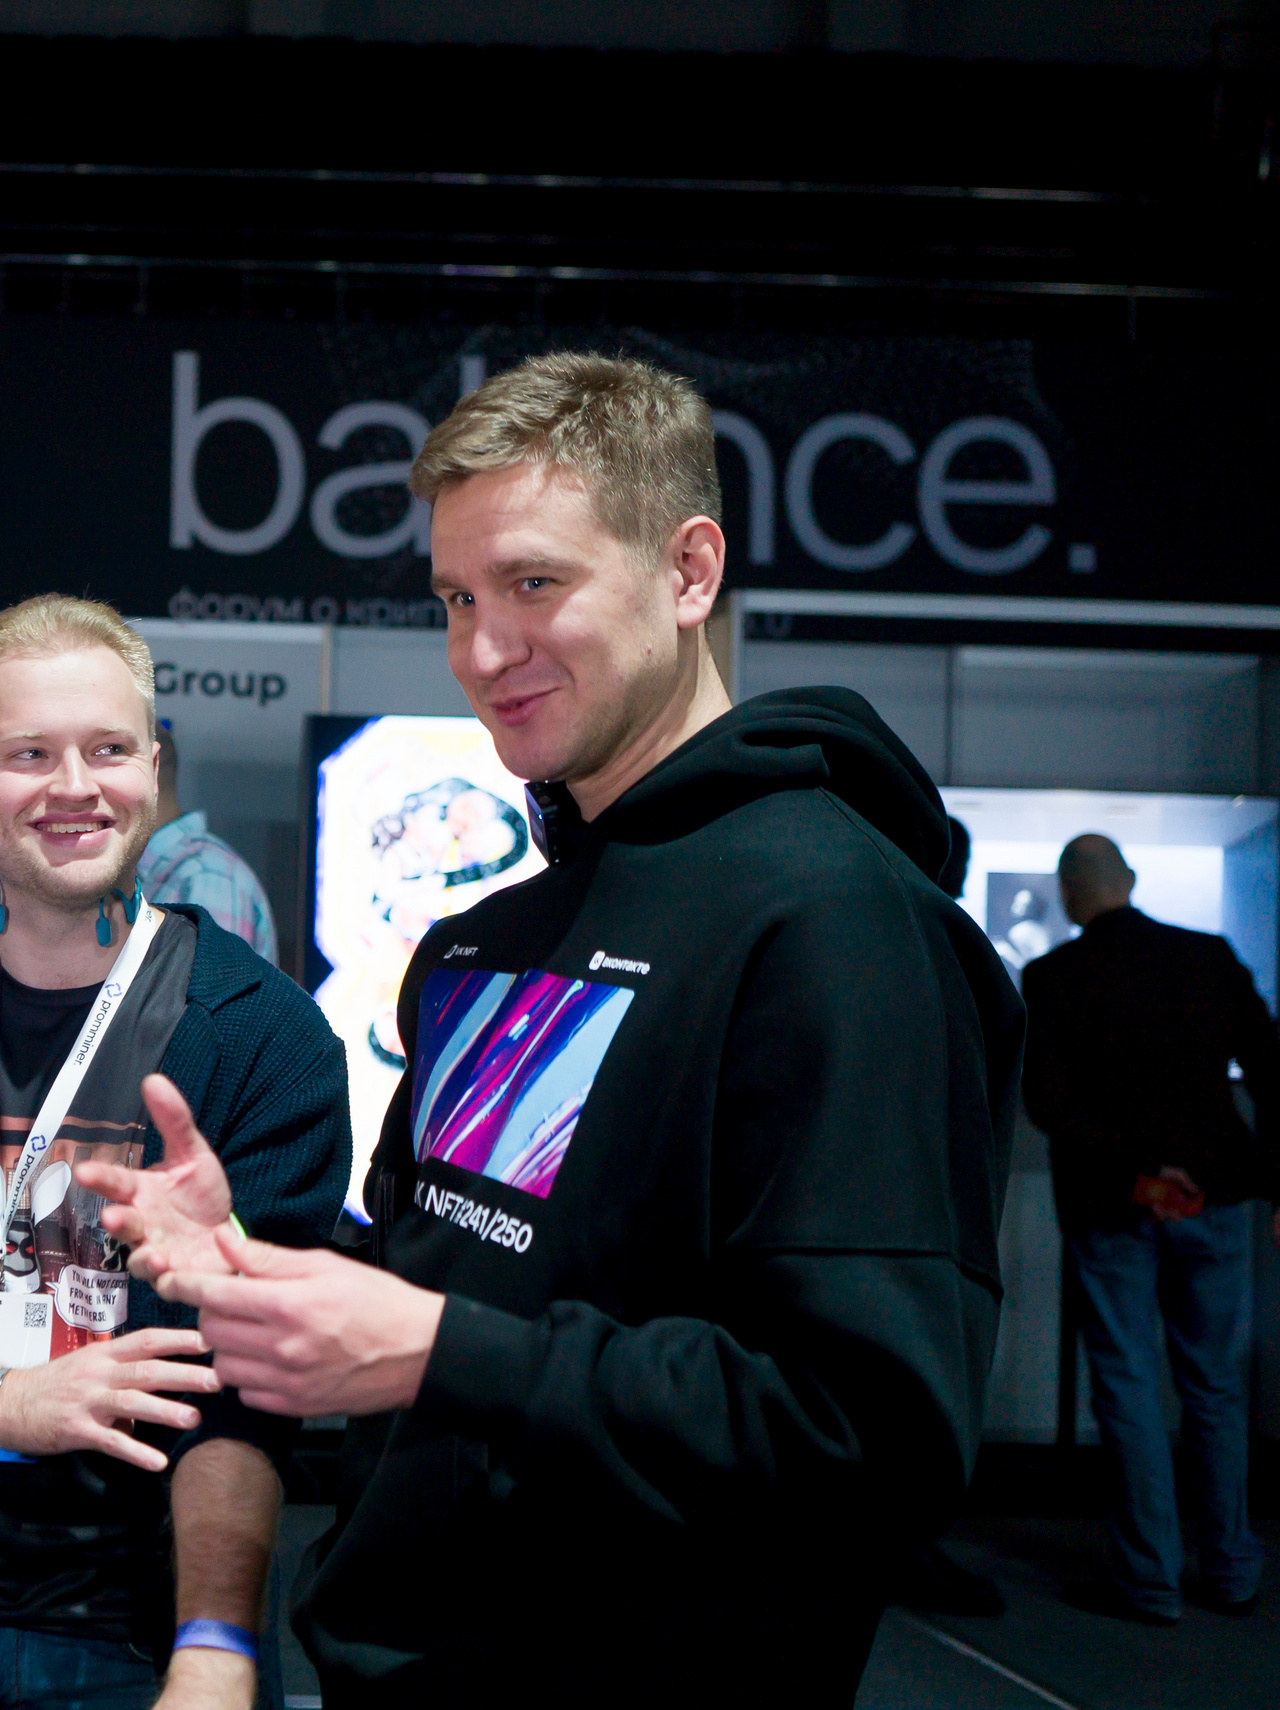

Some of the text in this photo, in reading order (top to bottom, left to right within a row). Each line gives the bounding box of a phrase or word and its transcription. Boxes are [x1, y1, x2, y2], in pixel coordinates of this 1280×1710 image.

[170, 349, 1097, 574] bance.
[151, 661, 287, 706] Group
[413, 1179, 425, 1208] K
